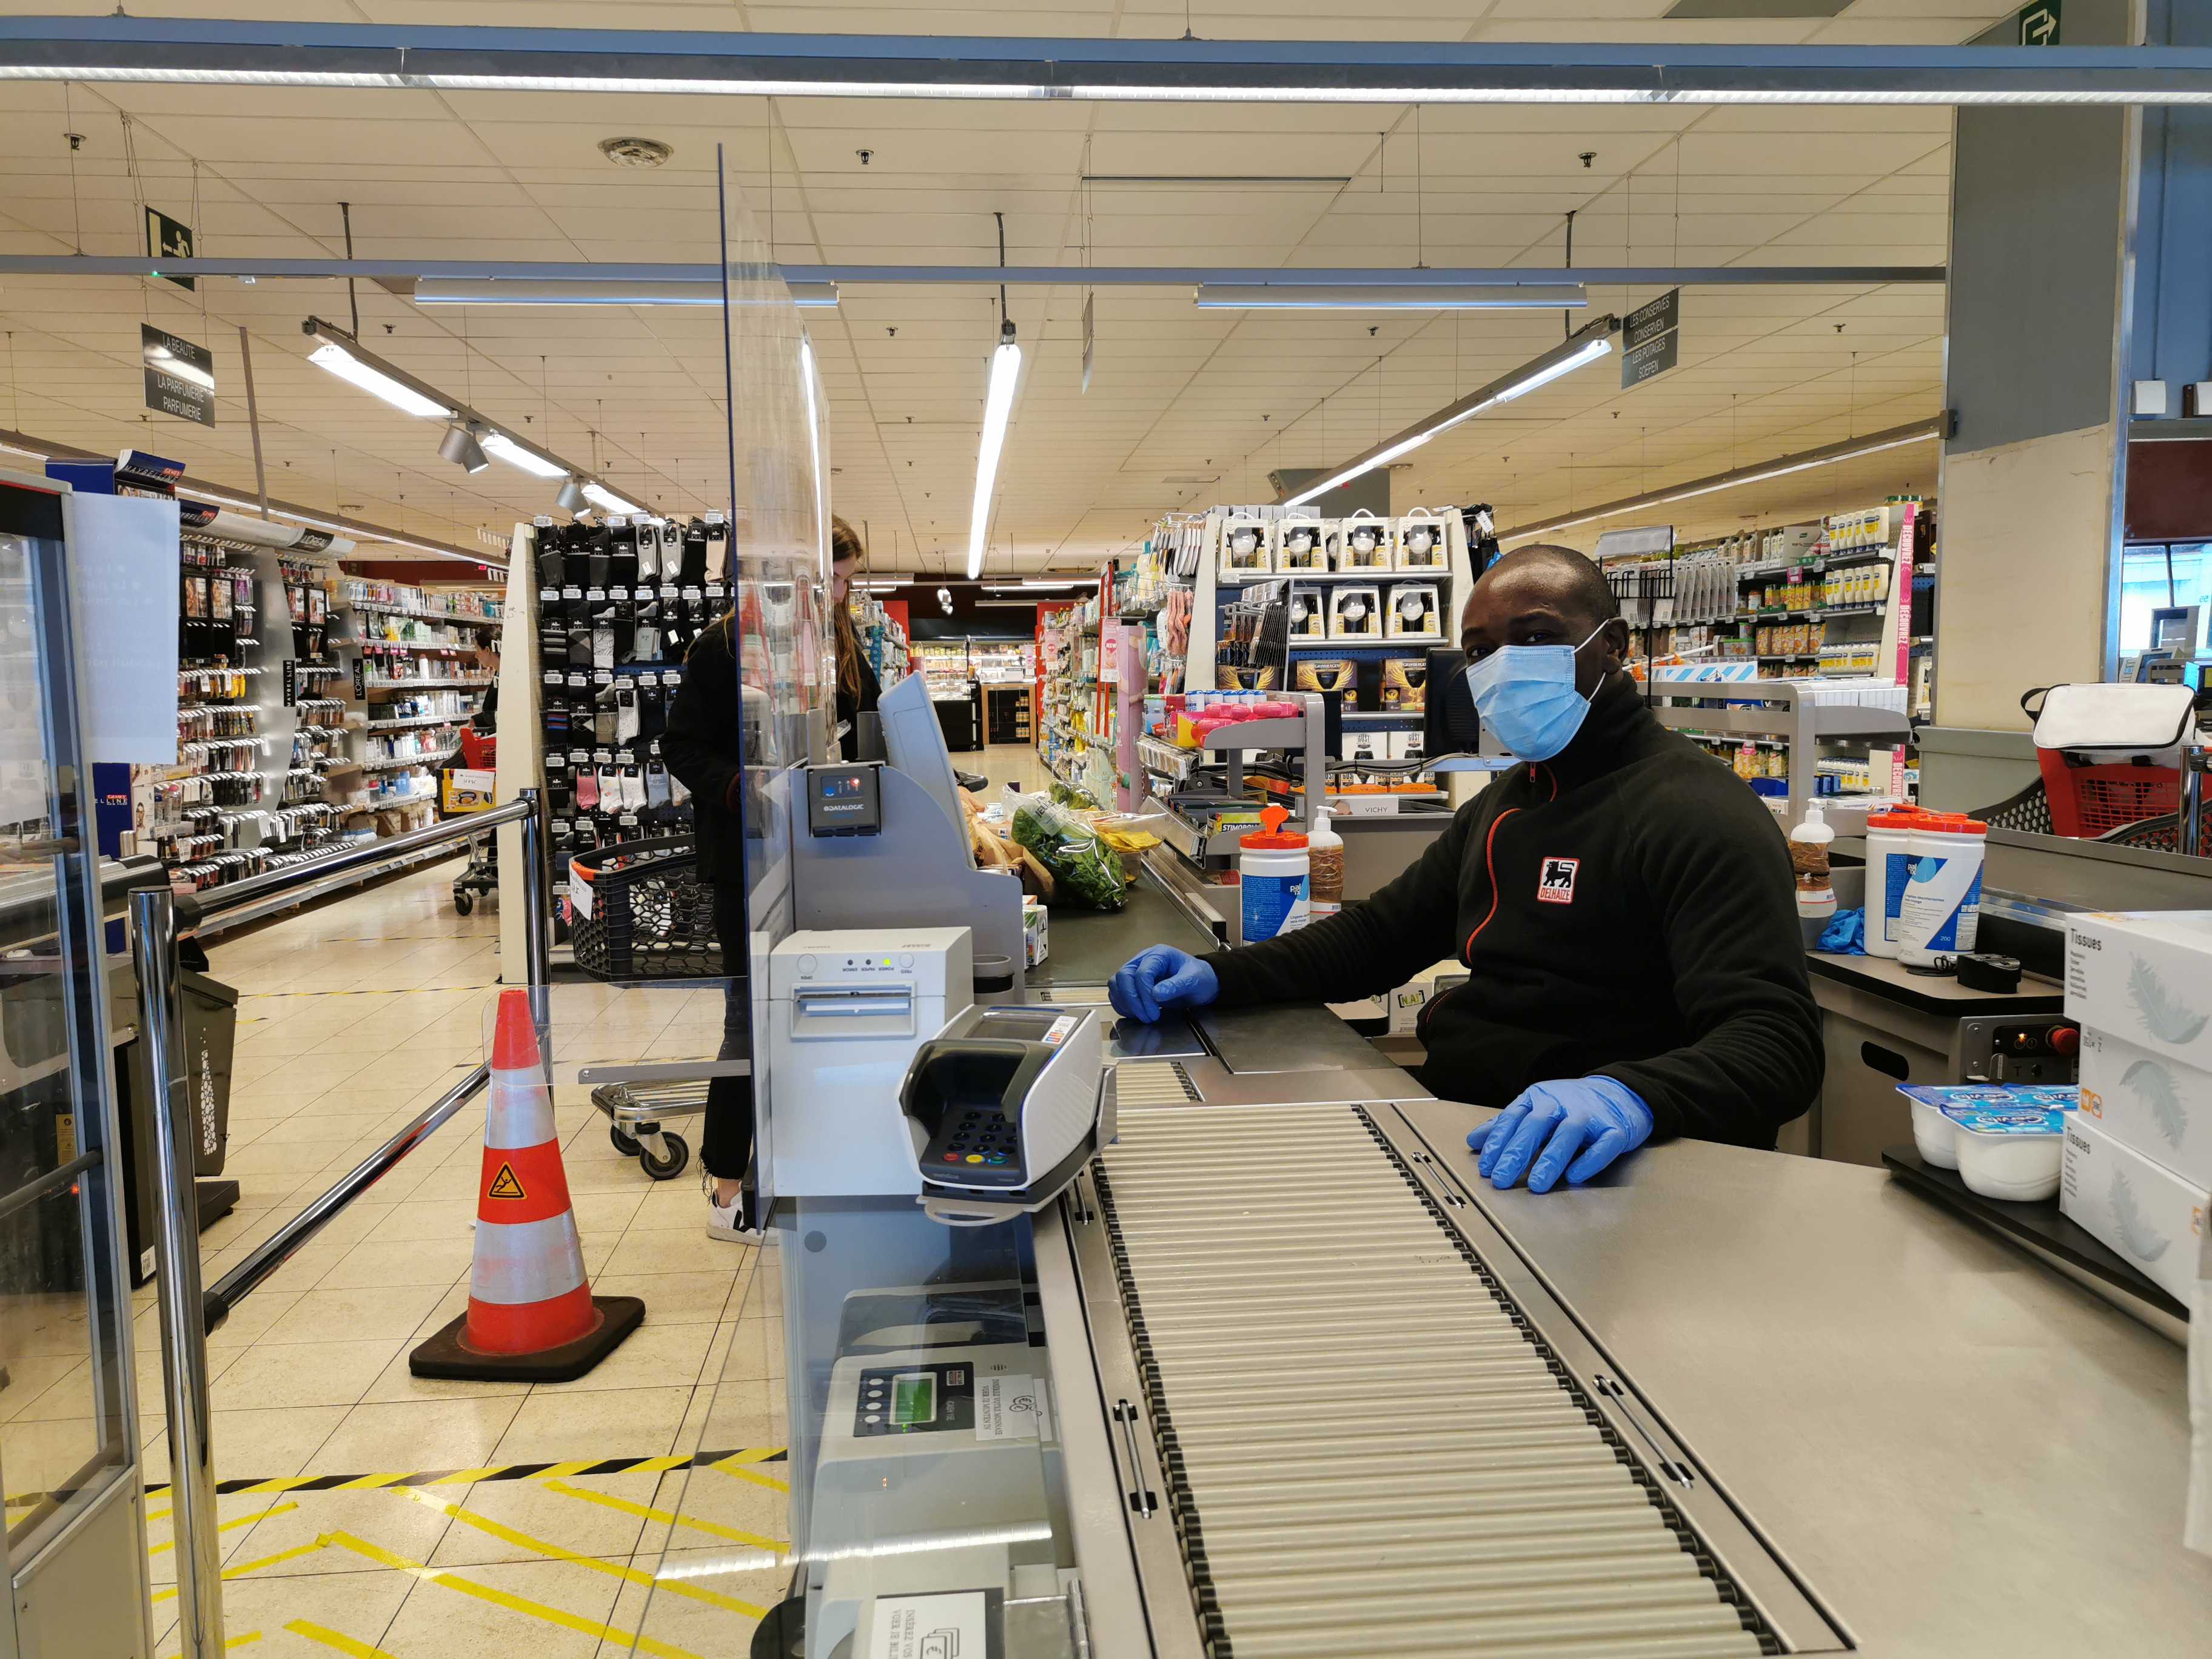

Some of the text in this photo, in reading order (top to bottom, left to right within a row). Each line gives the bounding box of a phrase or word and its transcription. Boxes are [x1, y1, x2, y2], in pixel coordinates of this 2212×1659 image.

[1630, 296, 1669, 328] LES CONSERVES
[163, 335, 171, 350] LA
[1634, 317, 1664, 343] CONSERVEN
[1632, 338, 1666, 364] LES POTAGES
[1638, 359, 1659, 379] SOEPEN
[157, 374, 204, 403] LA PARFUMERIE
[163, 396, 201, 421] PARFUMERIE
[1290, 883, 1301, 893] pal
[1540, 887, 1570, 900] DELHAIZE
[2071, 928, 2102, 951] Tissues
[2066, 1126, 2090, 1155] Tissues
